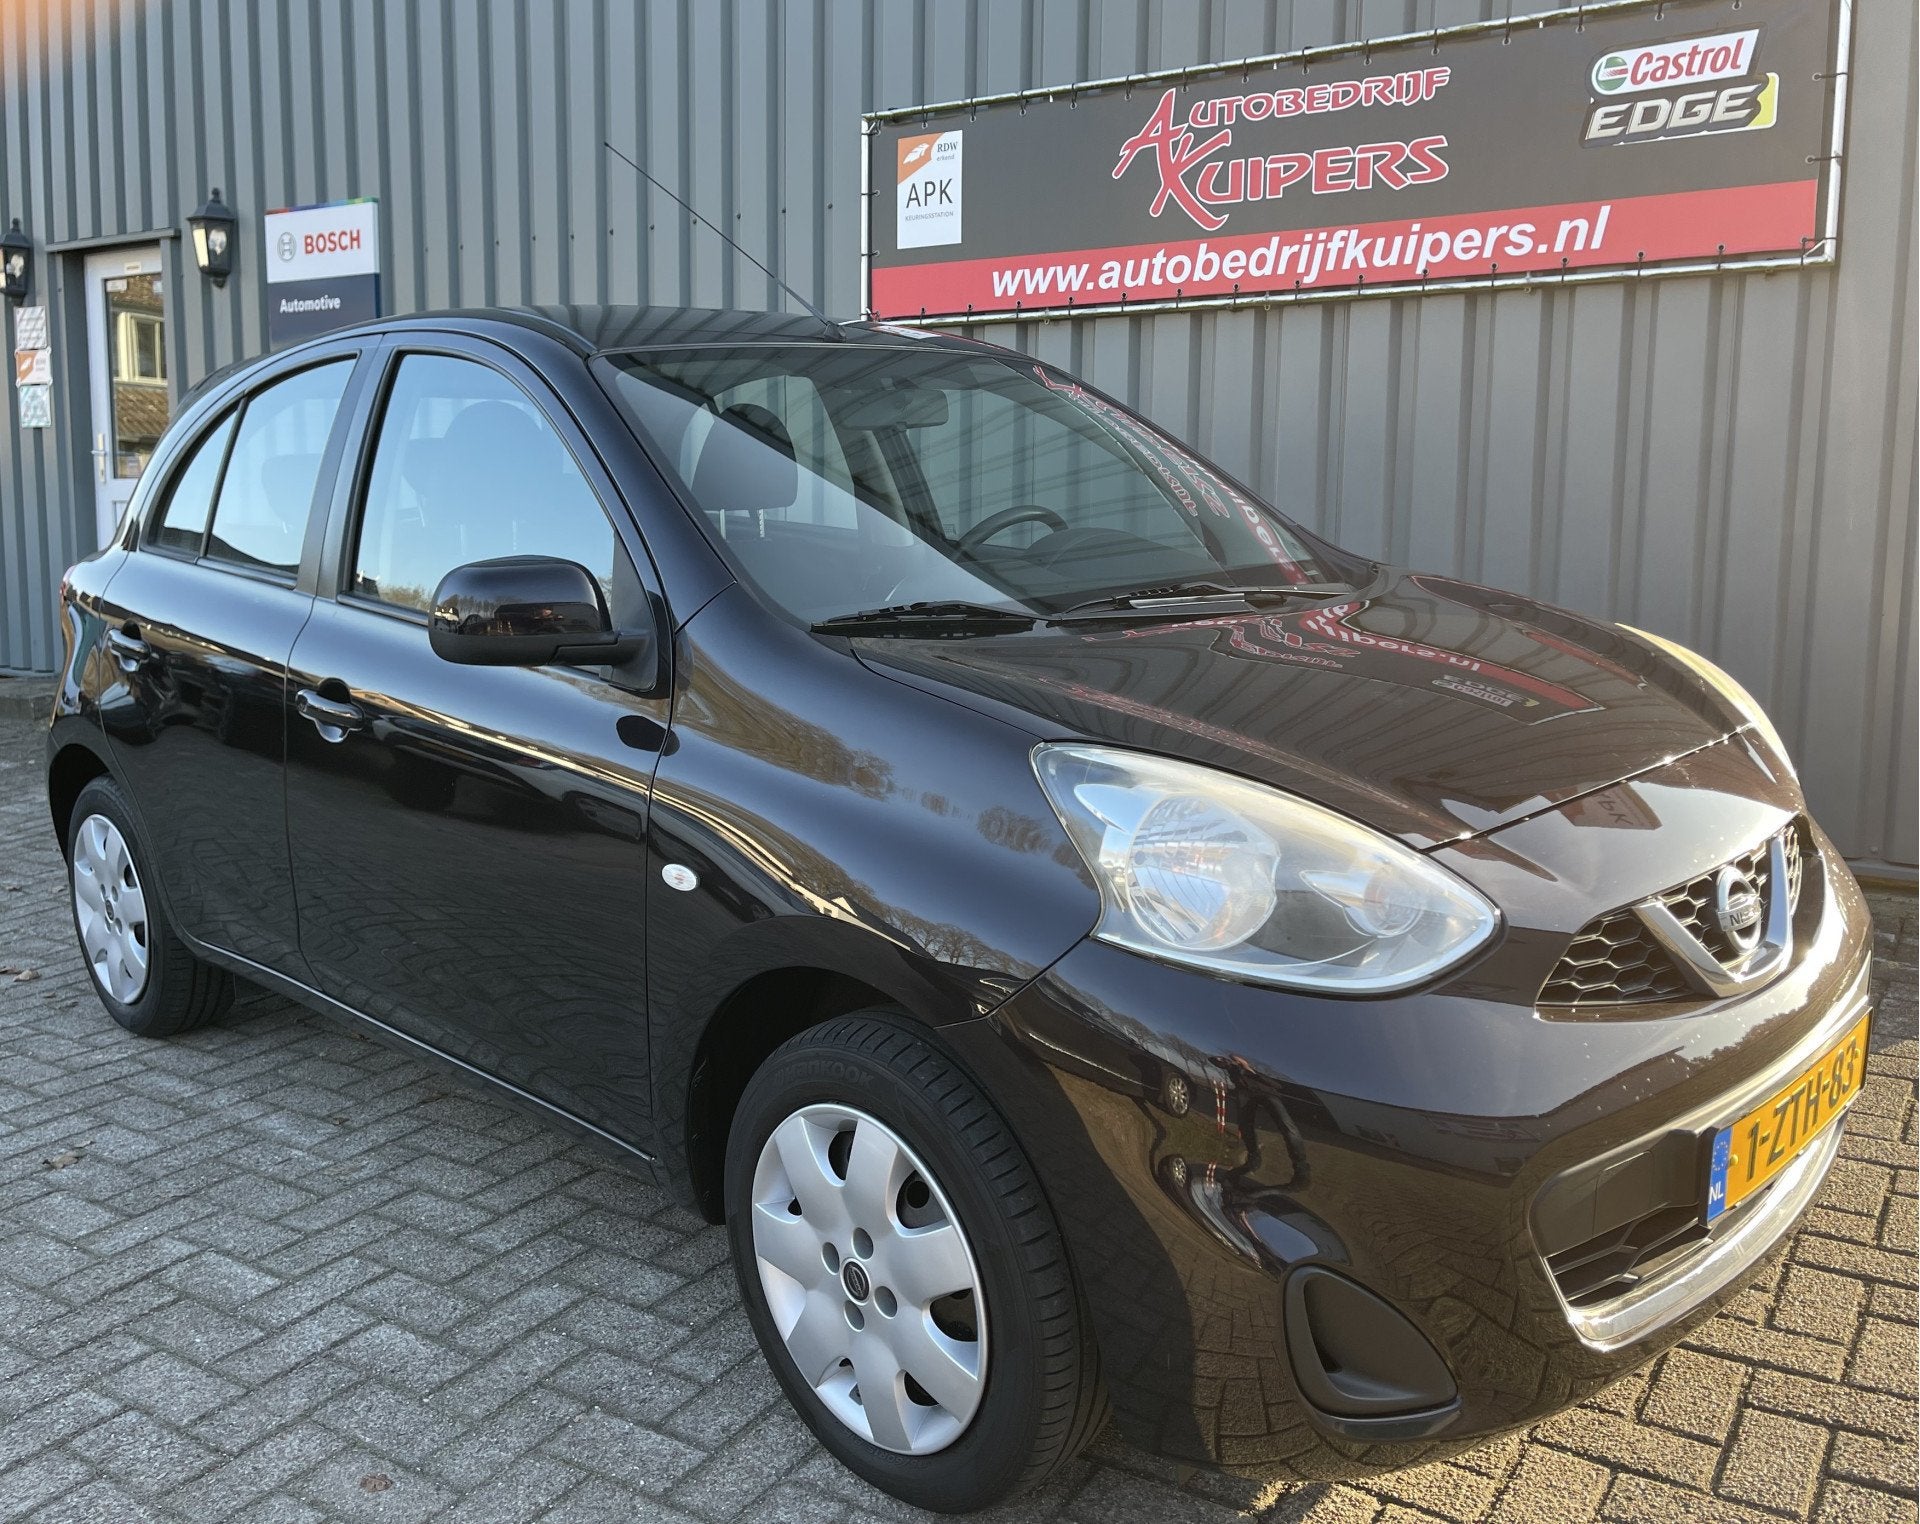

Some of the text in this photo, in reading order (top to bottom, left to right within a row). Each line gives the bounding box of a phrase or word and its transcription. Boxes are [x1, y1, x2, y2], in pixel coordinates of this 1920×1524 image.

[1630, 37, 1746, 86] Castrol
[1585, 84, 1762, 141] EDGE
[937, 141, 958, 153] RDW
[905, 178, 953, 209] APK
[1150, 129, 1449, 231] KUIPERS
[905, 211, 954, 221] KEURINGSSTATION
[304, 229, 361, 254] BOSCH
[992, 205, 1612, 297] www.autobedrijfkuipers.nl
[280, 295, 341, 313] Automotive
[1746, 1035, 1857, 1183] 1-ZTH-83
[1708, 1181, 1724, 1205] NL
